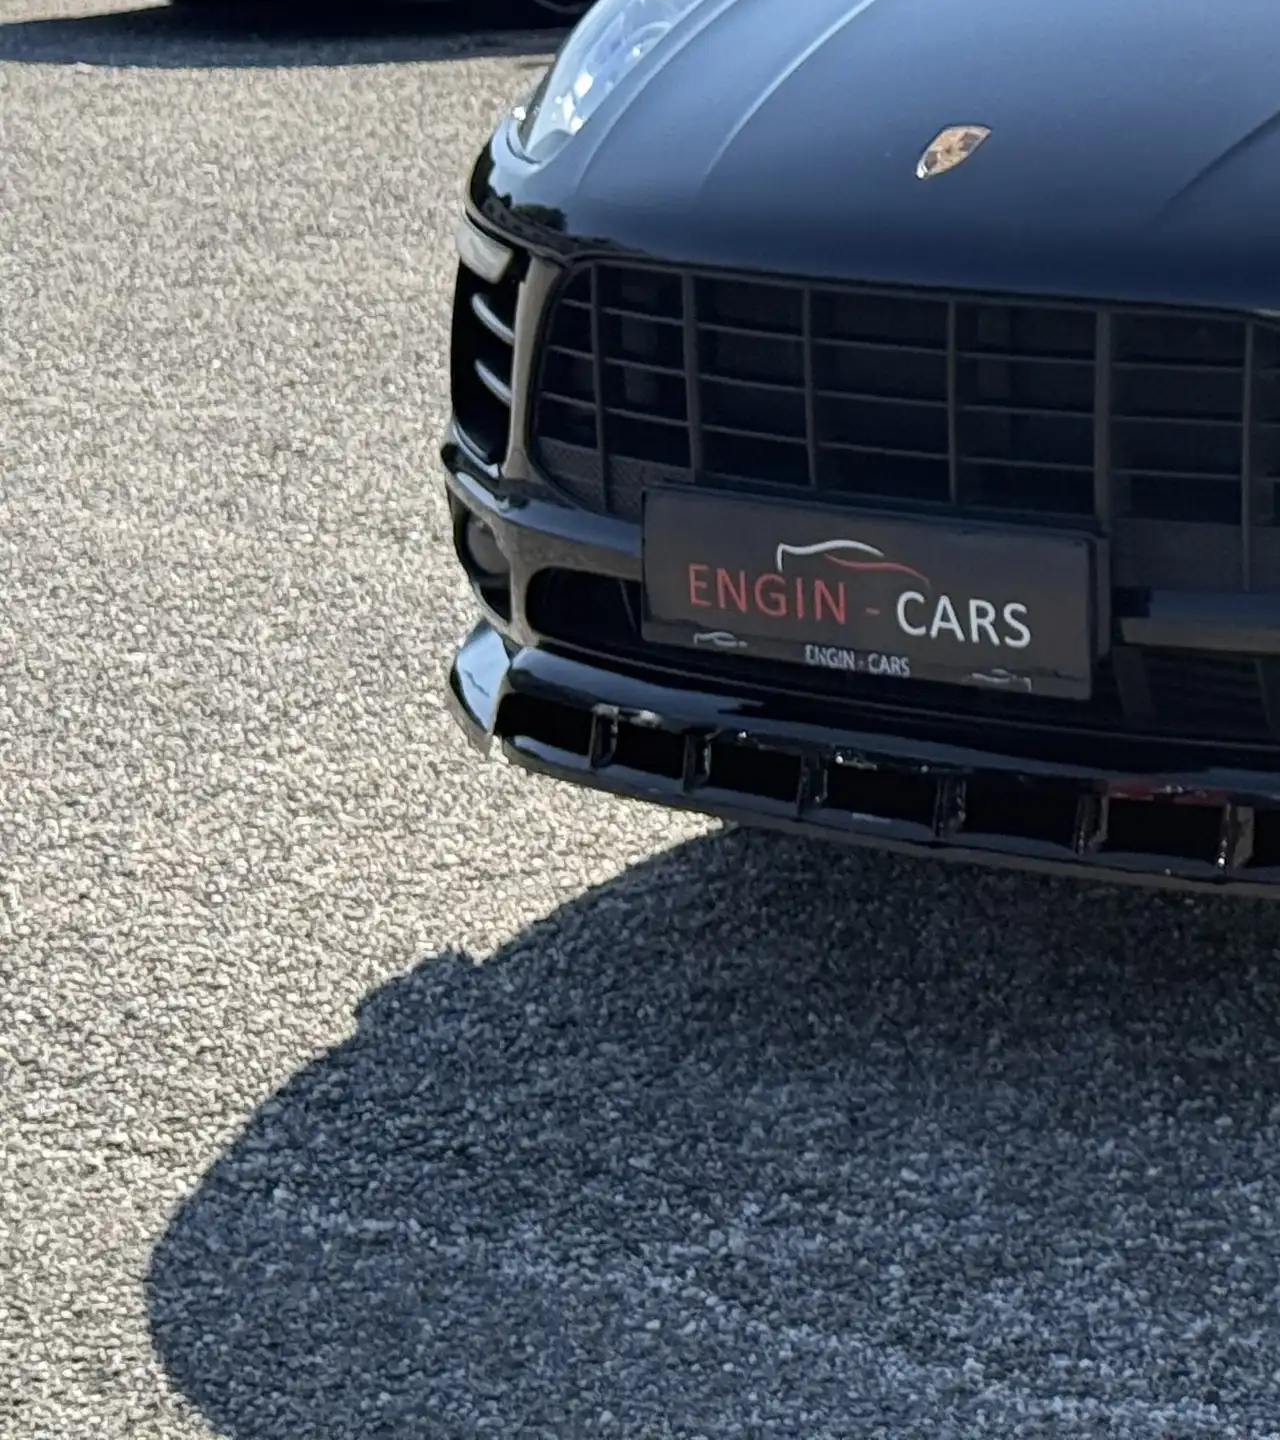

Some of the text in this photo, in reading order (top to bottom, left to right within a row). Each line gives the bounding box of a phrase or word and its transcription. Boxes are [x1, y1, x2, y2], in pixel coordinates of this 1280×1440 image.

[687, 563, 847, 625] ENGIN
[896, 590, 1032, 649] CARS
[804, 643, 856, 672] ENGIN
[867, 652, 911, 679] CARS
